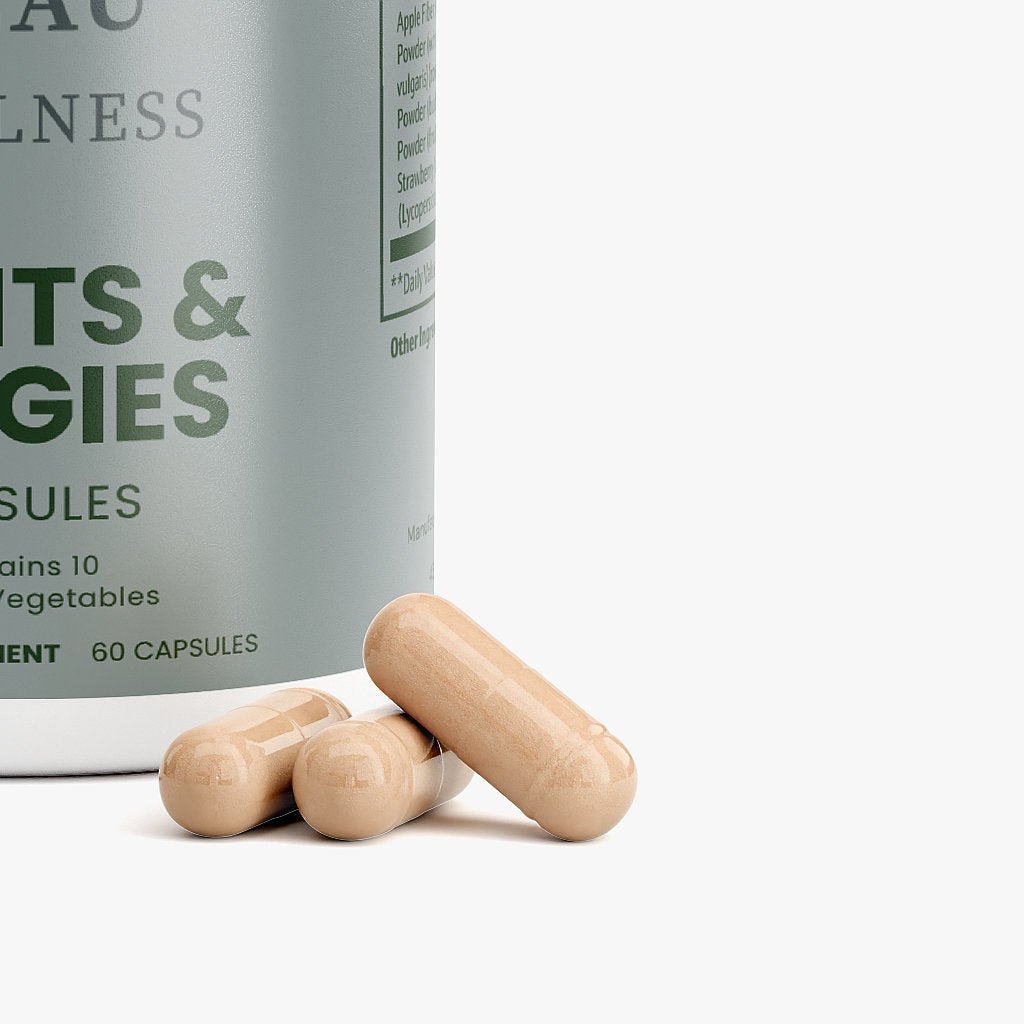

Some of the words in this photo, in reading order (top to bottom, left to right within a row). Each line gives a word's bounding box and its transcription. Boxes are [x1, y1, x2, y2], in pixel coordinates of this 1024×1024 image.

[397, 6, 421, 37] Apple
[397, 38, 426, 64] Powder
[397, 101, 426, 129] Powder
[397, 134, 426, 161] Powder
[172, 259, 252, 342] &
[390, 333, 418, 358] Other
[71, 554, 99, 576] 10
[91, 640, 125, 663] 60
[133, 633, 259, 661] CAPSULES
